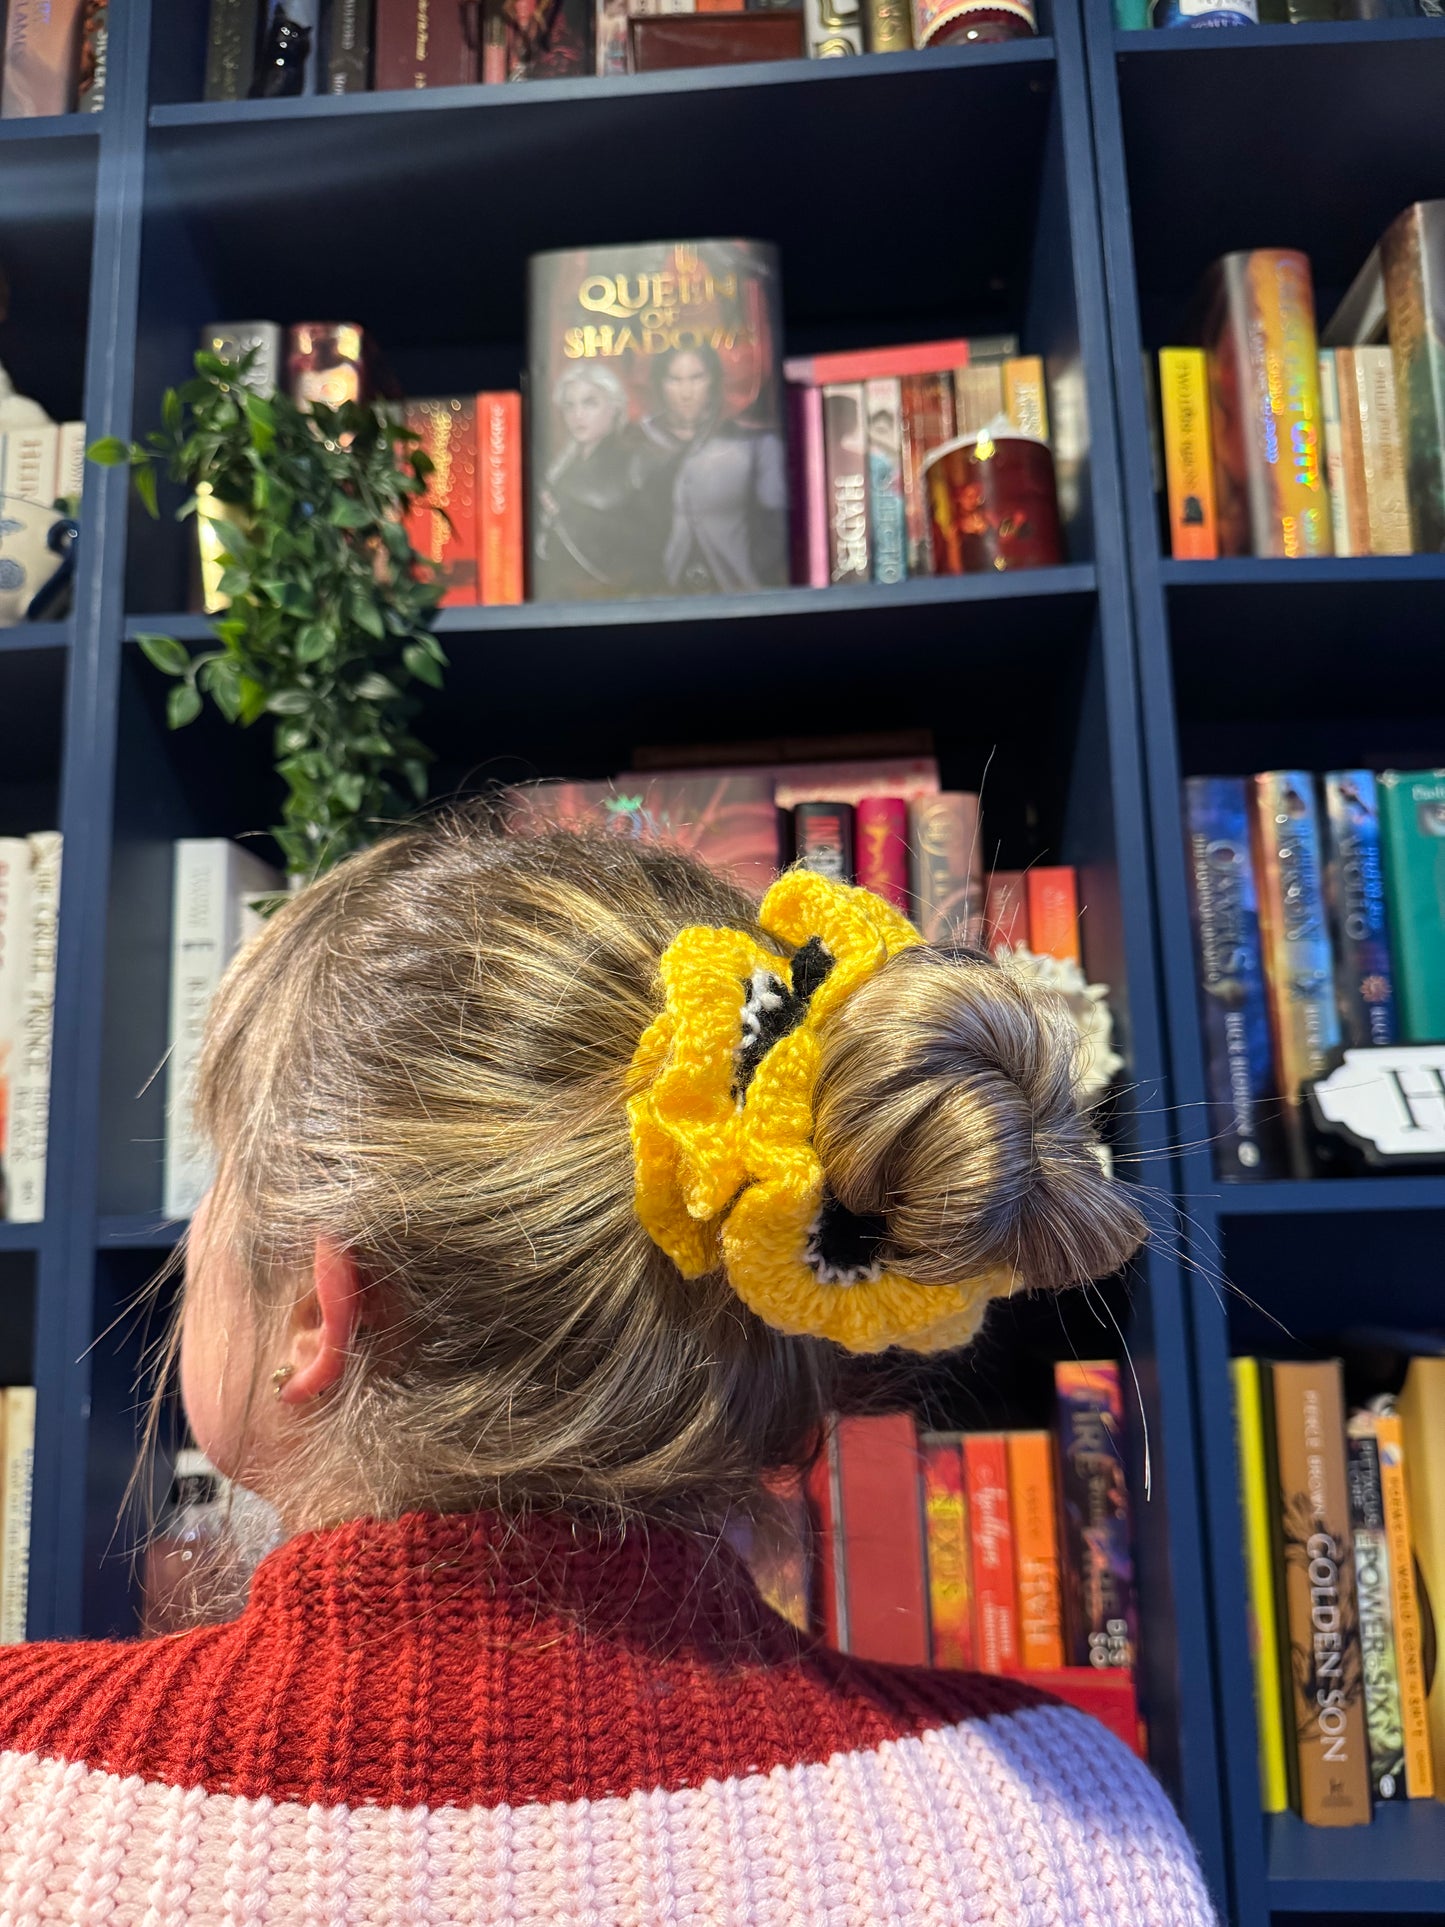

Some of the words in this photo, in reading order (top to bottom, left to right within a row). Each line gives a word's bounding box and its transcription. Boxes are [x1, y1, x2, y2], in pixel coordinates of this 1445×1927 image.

[578, 270, 738, 319] QUEEN
[640, 306, 680, 329] OF
[1290, 420, 1320, 492] CITY
[1307, 1454, 1327, 1515] BROWN
[1307, 1532, 1343, 1678] GOLDEN
[1356, 1548, 1385, 1650] POWER
[1403, 1627, 1418, 1675] GONE
[1364, 1669, 1393, 1716] SIX
[1316, 1688, 1349, 1763] SON
